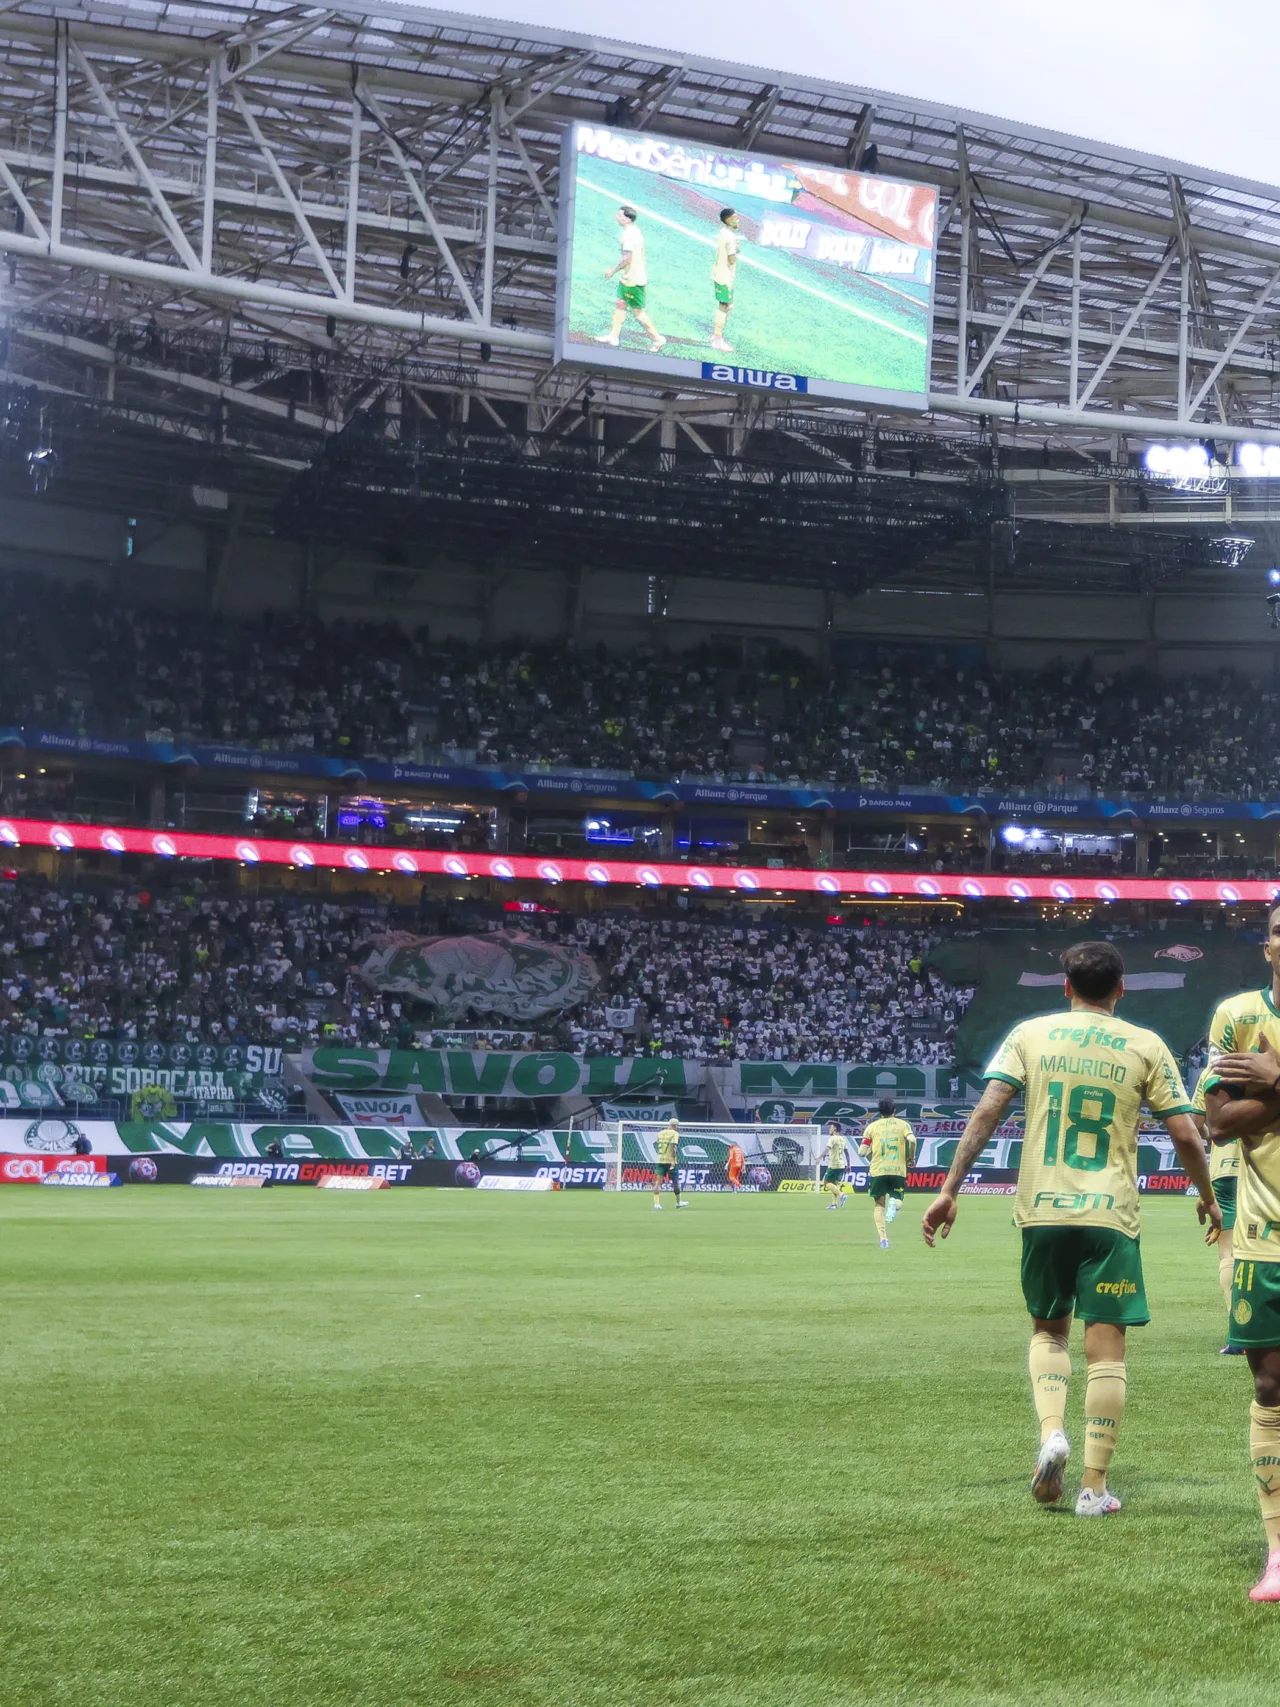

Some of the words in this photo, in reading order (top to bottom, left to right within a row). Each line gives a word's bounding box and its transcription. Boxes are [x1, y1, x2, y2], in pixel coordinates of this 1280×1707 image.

[711, 363, 799, 392] aiwa
[40, 734, 77, 748] Allianz
[214, 752, 249, 766] Allianz
[264, 756, 299, 770] Seguros
[537, 778, 570, 791] Allianz
[584, 781, 617, 794] Seguros
[695, 788, 727, 799] Allianz
[739, 792, 769, 803] Parque
[869, 799, 894, 807] BANCO
[895, 800, 912, 808] PAN
[998, 801, 1033, 814] Allianz
[1046, 802, 1078, 815] Parque
[1149, 805, 1180, 816] Allianz
[1193, 805, 1225, 817] Seguros
[1048, 1026, 1128, 1052] crefisa
[1040, 1054, 1127, 1085] MAURICIO
[1043, 1081, 1117, 1173] 18
[879, 1136, 900, 1161] 15
[5, 1159, 48, 1178] GOL
[56, 1160, 97, 1174] GOL
[217, 1162, 412, 1182] APOSTAGANHABET
[959, 1184, 1005, 1195] Embracon
[1234, 1262, 1256, 1292] 41
[1095, 1279, 1138, 1298] crefisa
